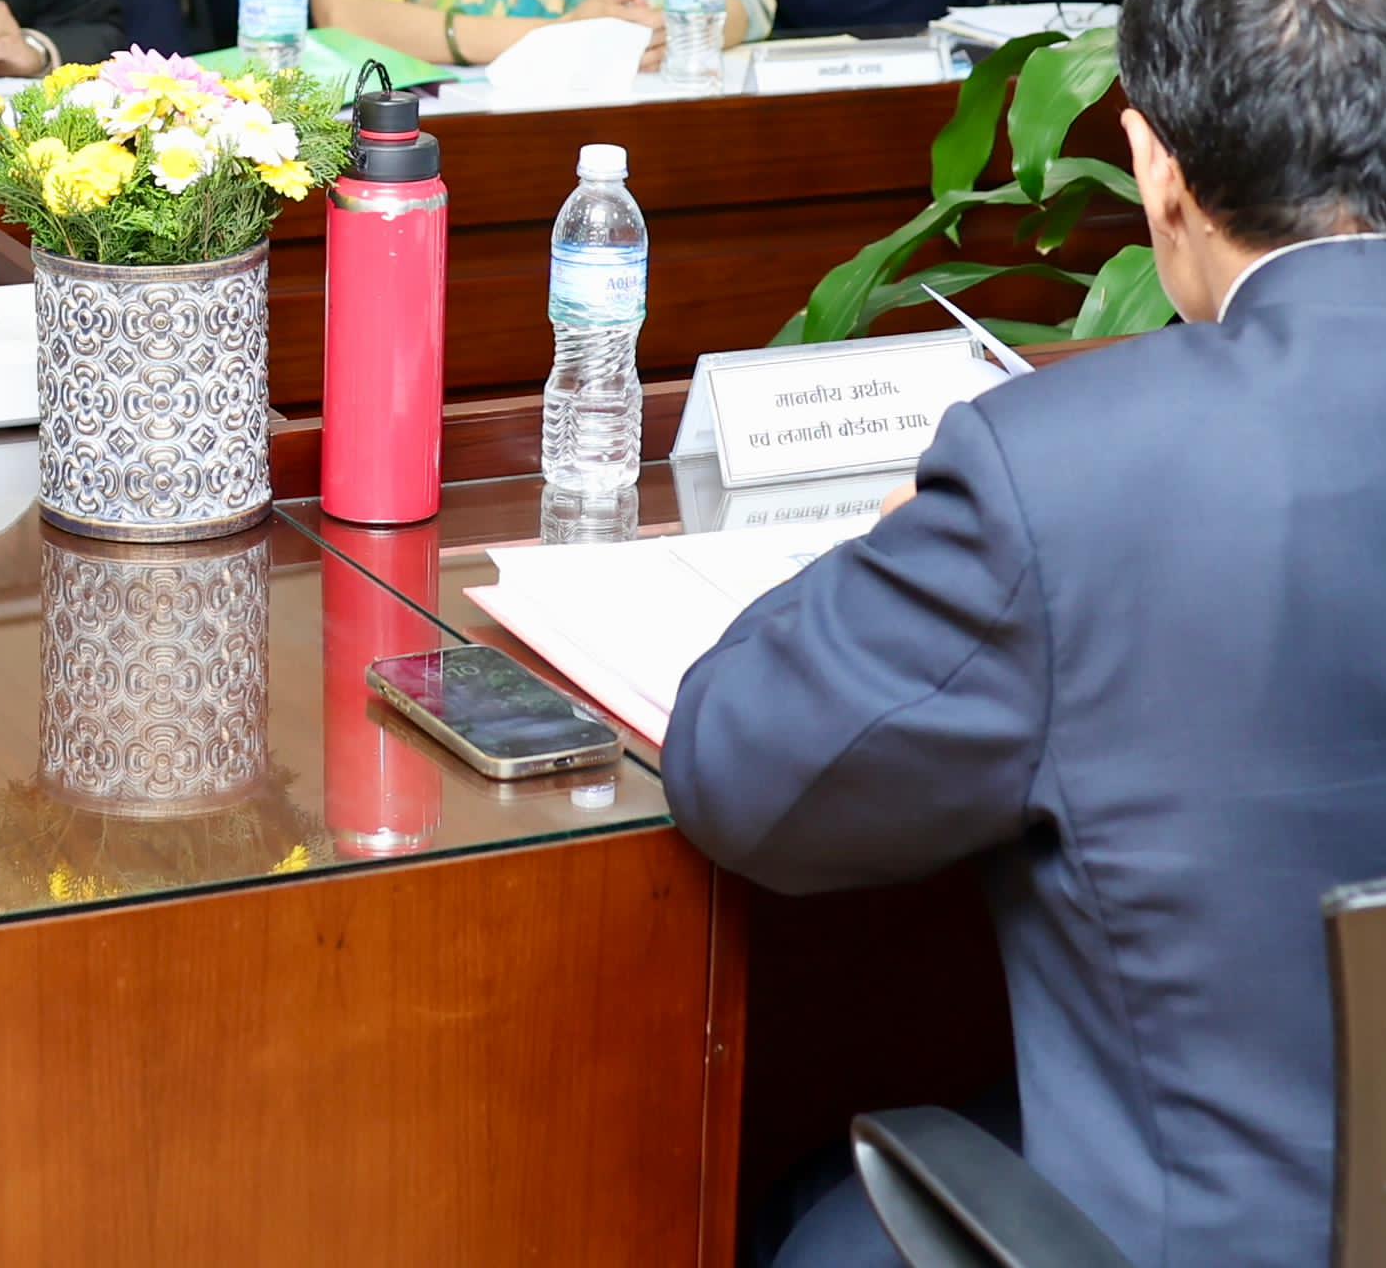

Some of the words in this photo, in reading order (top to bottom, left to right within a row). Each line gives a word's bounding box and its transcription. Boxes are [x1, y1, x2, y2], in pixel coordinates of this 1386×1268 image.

[774, 385, 843, 409] माननीय
[849, 379, 902, 402] अर्थम
[777, 420, 833, 447] लगानी
[837, 416, 890, 438] बोर्डका
[892, 412, 933, 432] उपा
